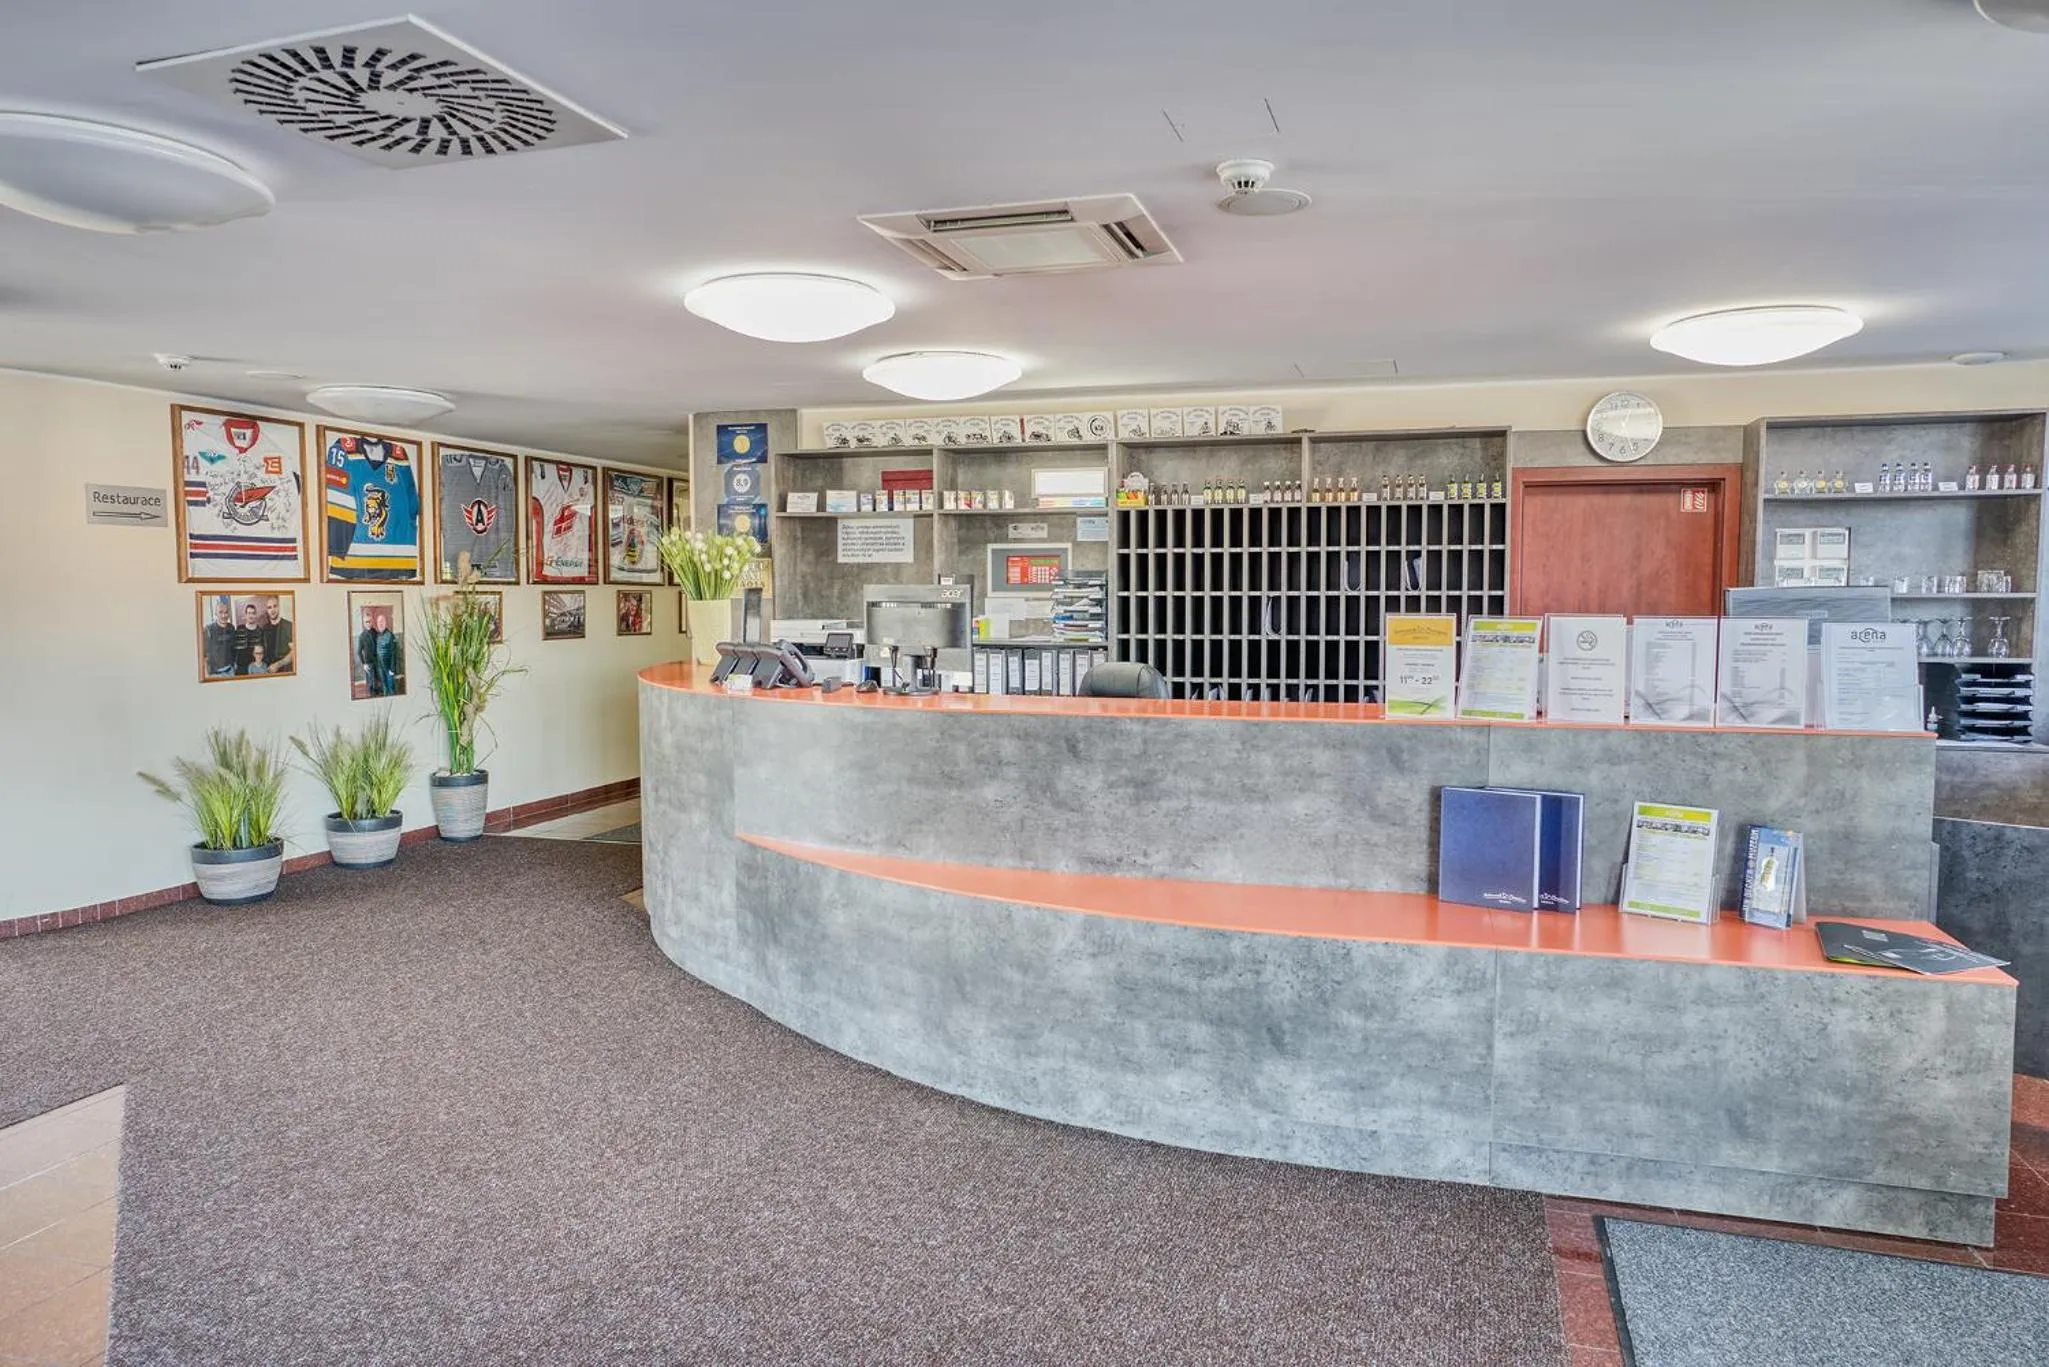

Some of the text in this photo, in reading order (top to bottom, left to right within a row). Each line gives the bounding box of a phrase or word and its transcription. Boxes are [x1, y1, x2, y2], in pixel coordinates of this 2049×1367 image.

[330, 447, 345, 468] 15
[92, 490, 161, 507] Restaurace
[940, 589, 963, 599] acer
[1850, 628, 1887, 642] arena
